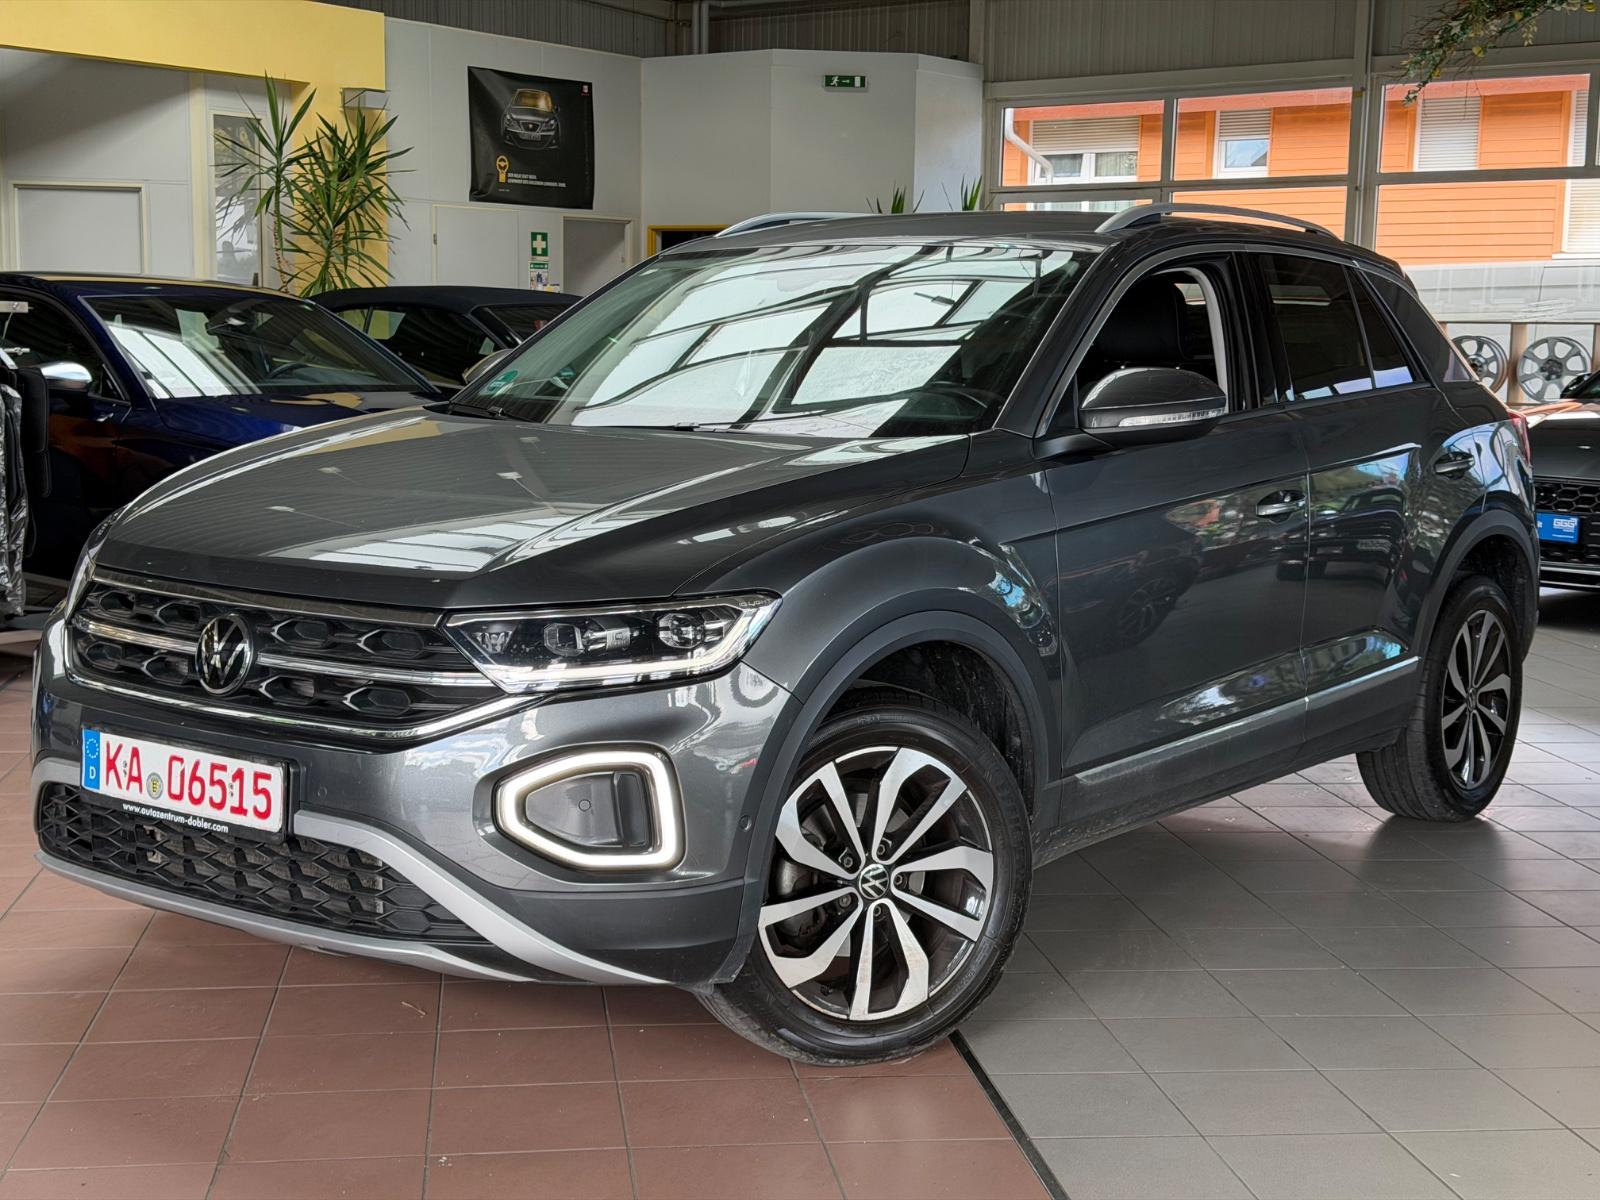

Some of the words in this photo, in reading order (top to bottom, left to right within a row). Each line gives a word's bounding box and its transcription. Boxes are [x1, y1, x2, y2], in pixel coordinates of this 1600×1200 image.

[89, 766, 97, 780] D
[105, 741, 143, 794] KA
[167, 754, 272, 820] 06515
[122, 802, 229, 834] www.autozentrum-dobler.com
